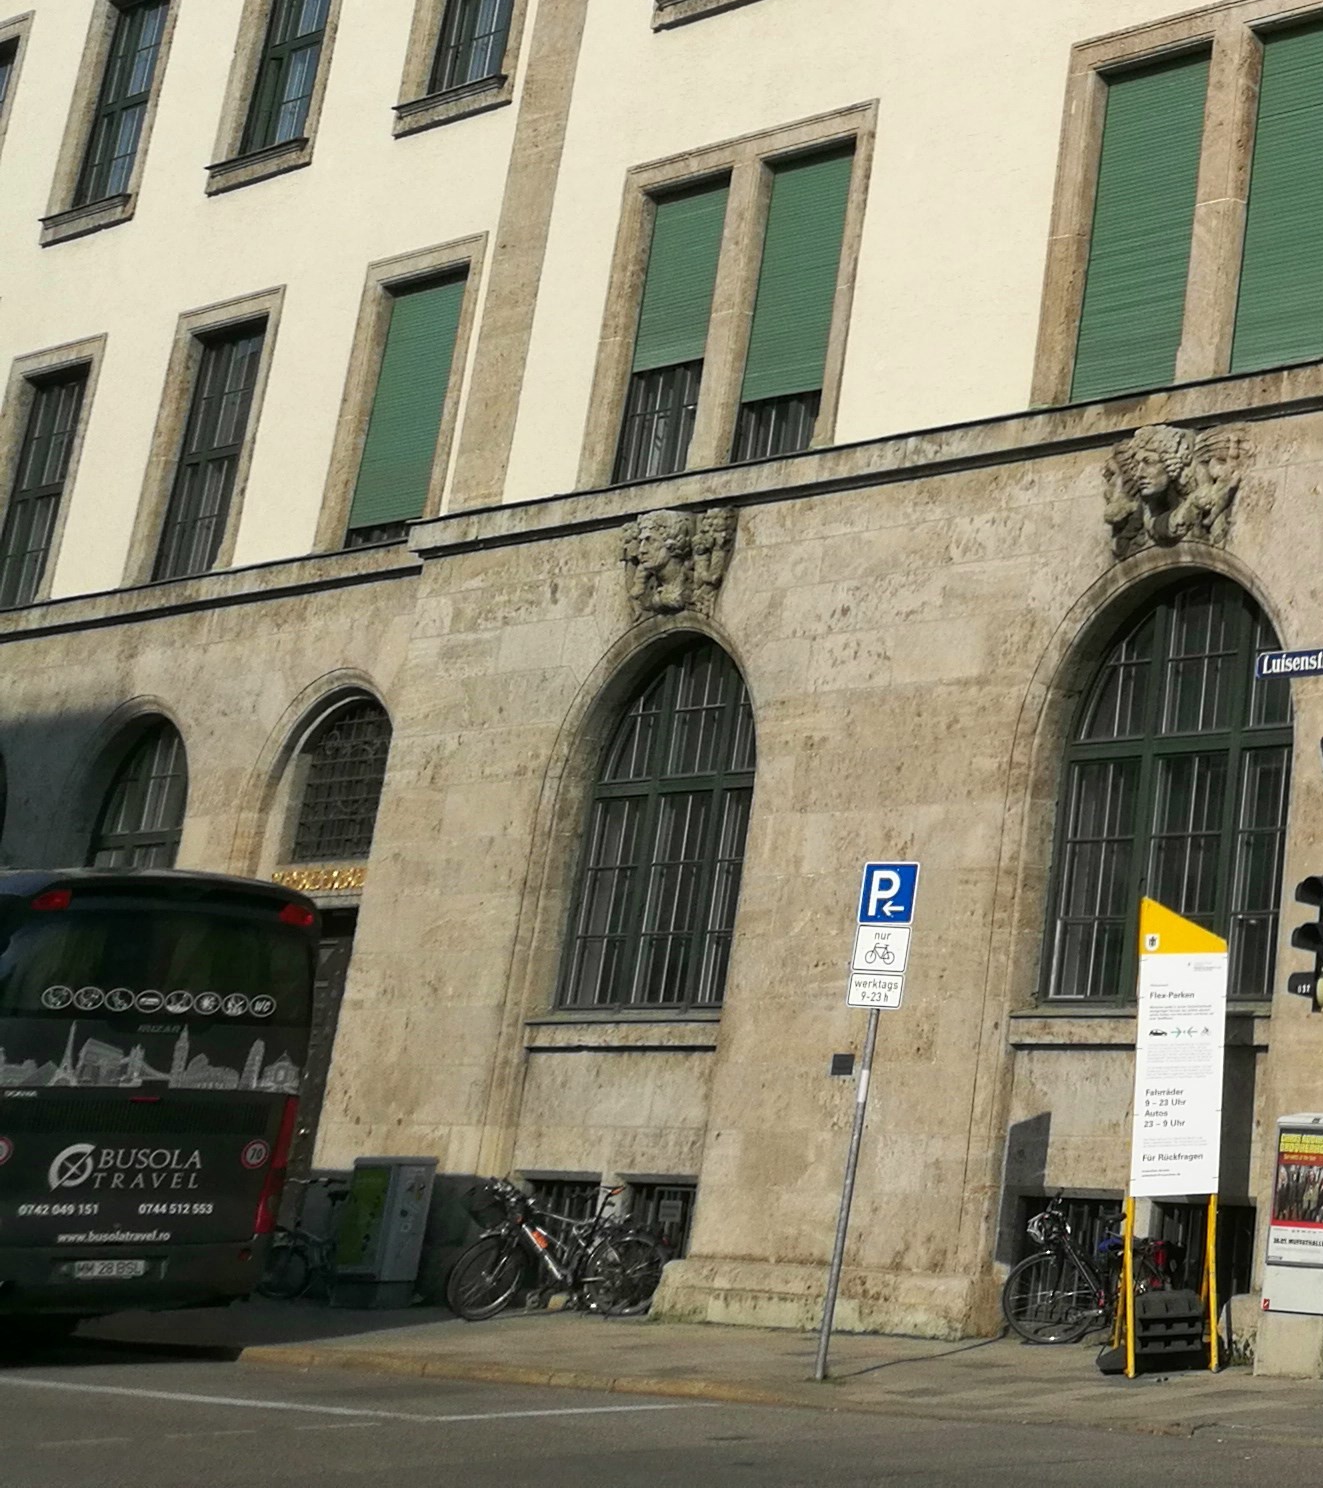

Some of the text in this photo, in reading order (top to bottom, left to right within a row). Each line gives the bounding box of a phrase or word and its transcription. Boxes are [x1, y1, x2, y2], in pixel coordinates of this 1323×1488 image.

[868, 870, 901, 916] P
[874, 932, 892, 941] nur
[854, 978, 899, 992] werktags
[1149, 991, 1195, 1000] Flex-Parken
[1145, 1089, 1184, 1097] Fahrräder
[1145, 1099, 1150, 1107] 9
[1171, 1098, 1187, 1106] Uhr
[1143, 1120, 1154, 1128] 23
[1170, 1119, 1186, 1127] Uhr
[98, 1148, 202, 1169] BUSOLA
[249, 1148, 263, 1160] 70
[1142, 1152, 1204, 1162] Für Rückfragen
[93, 1172, 200, 1189] TRAVEL
[18, 1203, 99, 1215] 0742 049 151
[138, 1202, 214, 1214] 0744 512 553
[57, 1229, 172, 1243] www.busolatravel.ro
[99, 1262, 114, 1274] 28
